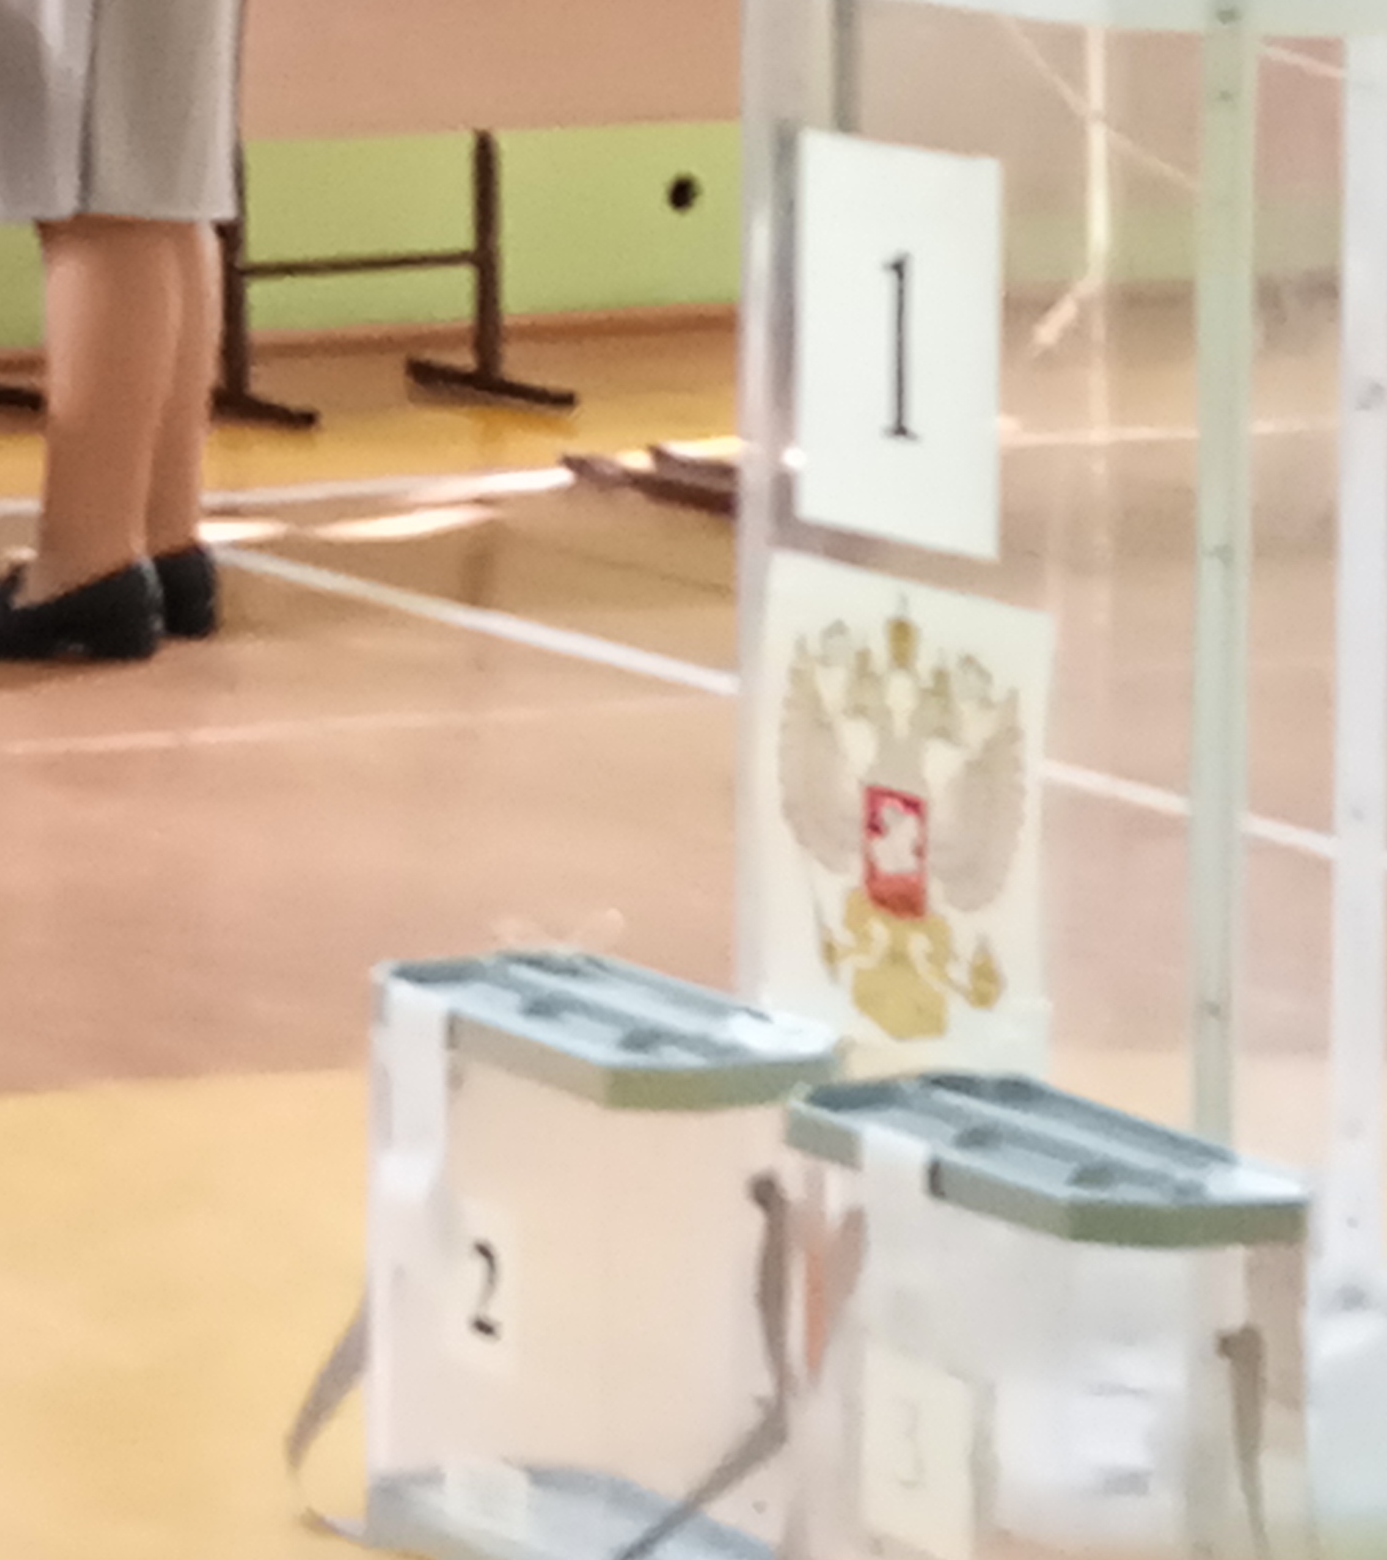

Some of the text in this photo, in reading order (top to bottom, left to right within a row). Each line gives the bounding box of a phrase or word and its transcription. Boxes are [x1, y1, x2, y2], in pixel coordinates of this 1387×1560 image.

[883, 252, 919, 441] 1
[468, 1239, 502, 1343] 2
[888, 1392, 925, 1491] 3
